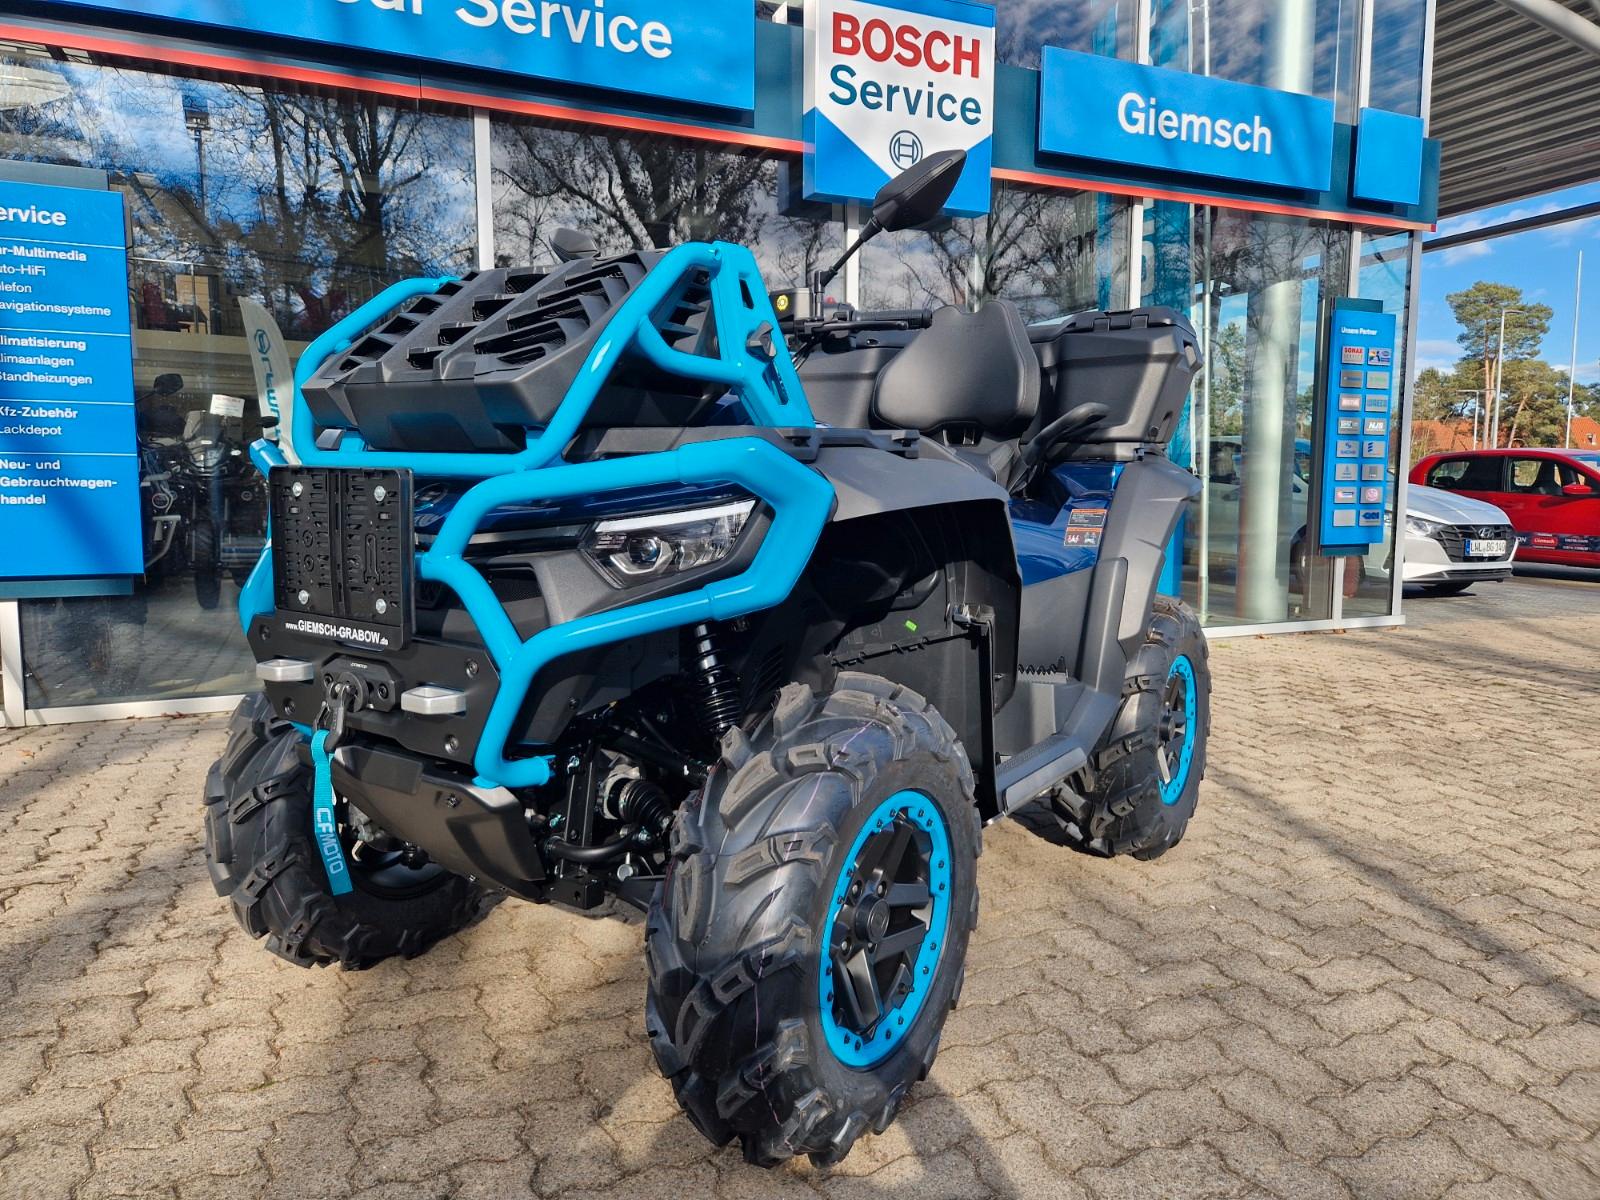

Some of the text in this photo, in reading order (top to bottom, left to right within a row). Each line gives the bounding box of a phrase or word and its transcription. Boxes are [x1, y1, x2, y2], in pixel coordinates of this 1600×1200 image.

[832, 11, 981, 79] BOSCH
[828, 63, 982, 126] Service
[1117, 92, 1272, 155] Giemsch
[0, 245, 87, 262] r-Multimedia
[0, 475, 118, 489] Gebrauchtwagen-
[35, 459, 61, 470] und
[0, 493, 46, 505] handel
[316, 807, 344, 875] CFMOTO
